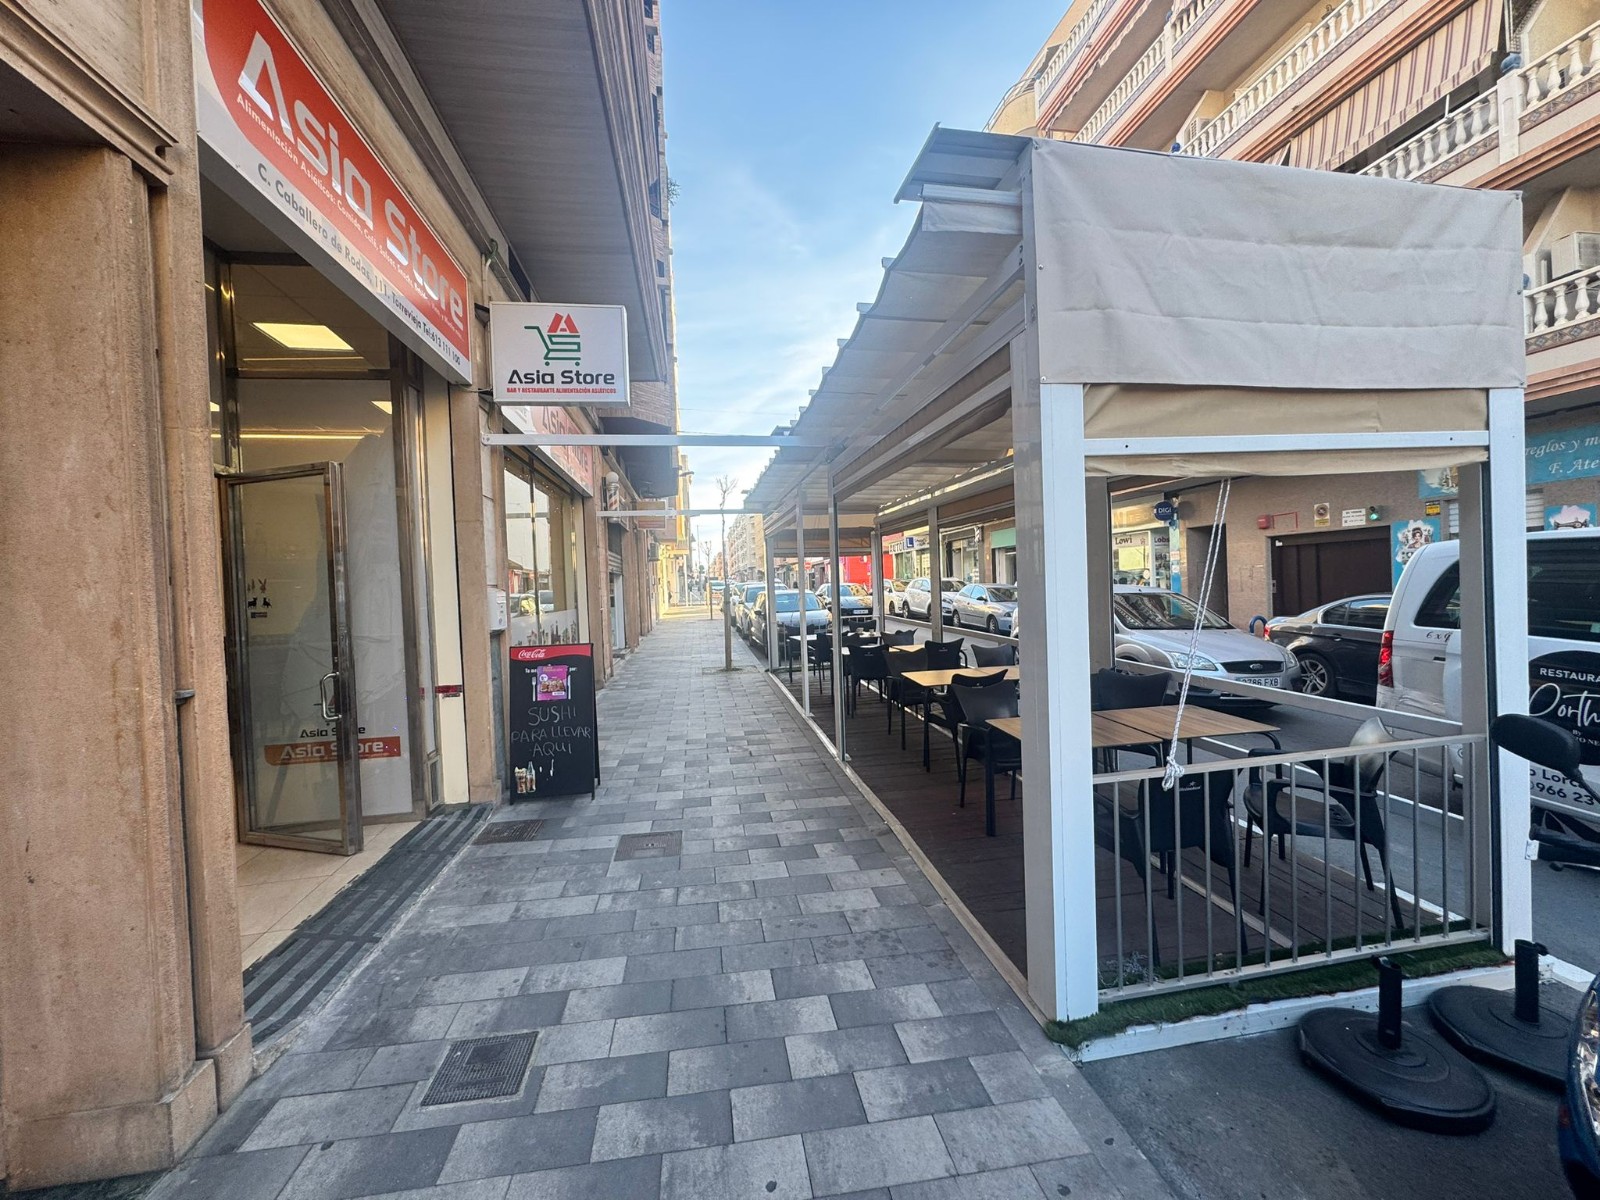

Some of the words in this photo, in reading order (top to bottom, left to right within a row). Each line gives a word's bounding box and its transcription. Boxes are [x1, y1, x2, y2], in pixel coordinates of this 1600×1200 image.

[237, 92, 299, 165] Alimentación
[238, 30, 373, 230] Asia
[385, 198, 463, 331] Store
[258, 163, 271, 186] C.
[275, 180, 328, 240] Caballero
[331, 235, 342, 253] de
[392, 291, 422, 329] Torrevieja
[508, 369, 555, 384] Asia
[561, 370, 615, 385] Store
[1568, 439, 1580, 453] y
[528, 706, 576, 726] SUSHI
[300, 728, 328, 738] Asia
[511, 728, 547, 743] PARA
[551, 726, 591, 740] LLEVAR
[281, 744, 325, 760] Asia
[1536, 782, 1567, 799] 966
